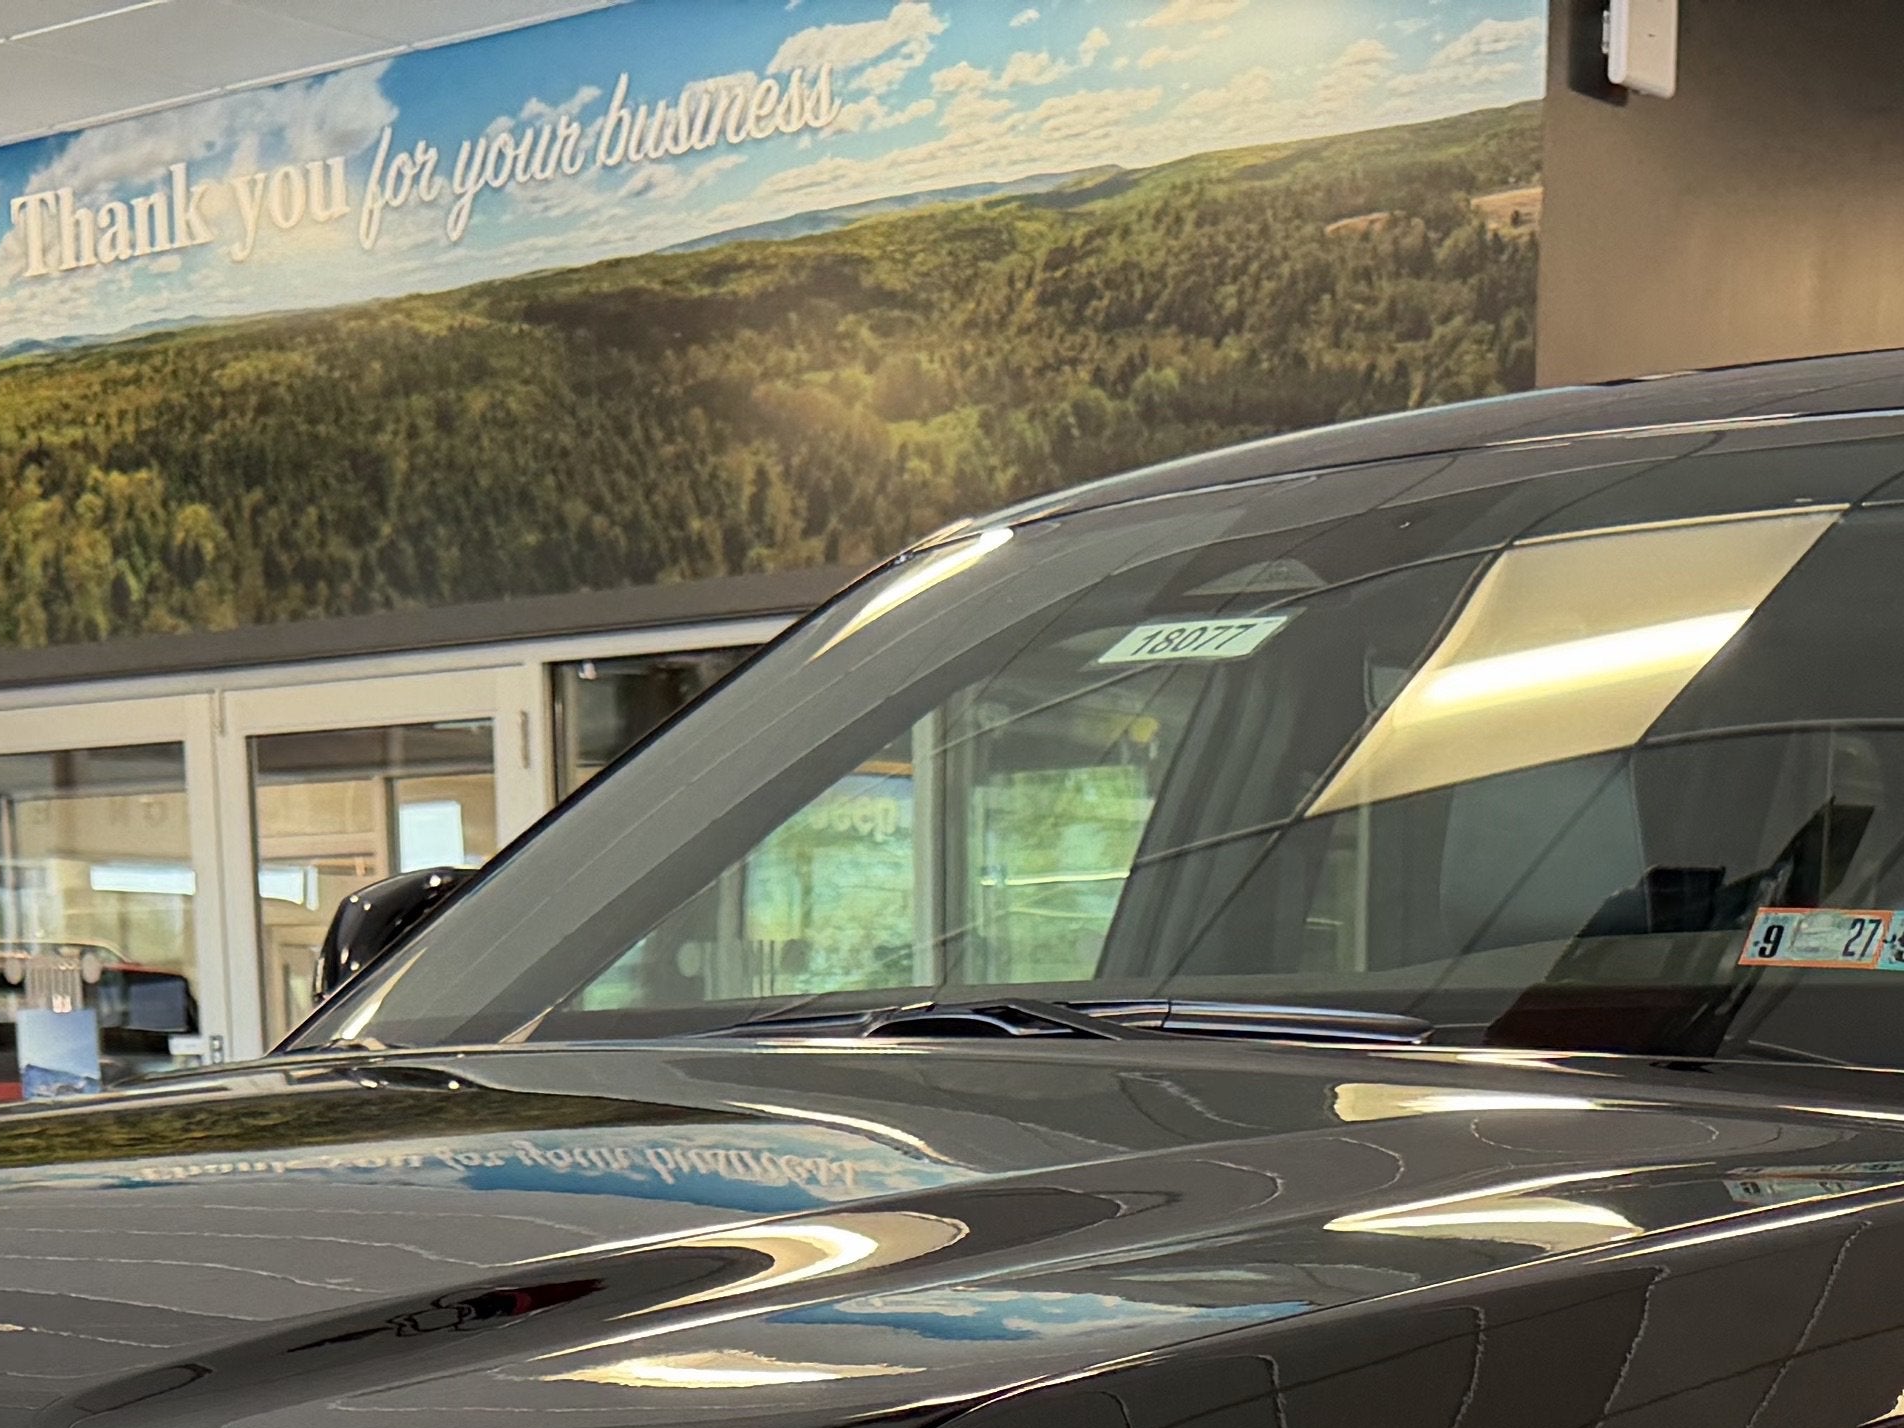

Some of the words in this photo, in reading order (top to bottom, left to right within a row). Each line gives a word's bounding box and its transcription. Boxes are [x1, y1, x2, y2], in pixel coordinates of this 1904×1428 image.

[10, 162, 214, 278] Thank
[228, 154, 351, 263] you
[359, 125, 445, 251] for
[446, 108, 587, 243] your
[596, 60, 847, 166] business
[1129, 621, 1258, 657] 18077
[1758, 924, 1785, 959] 9
[1842, 918, 1883, 961] 27
